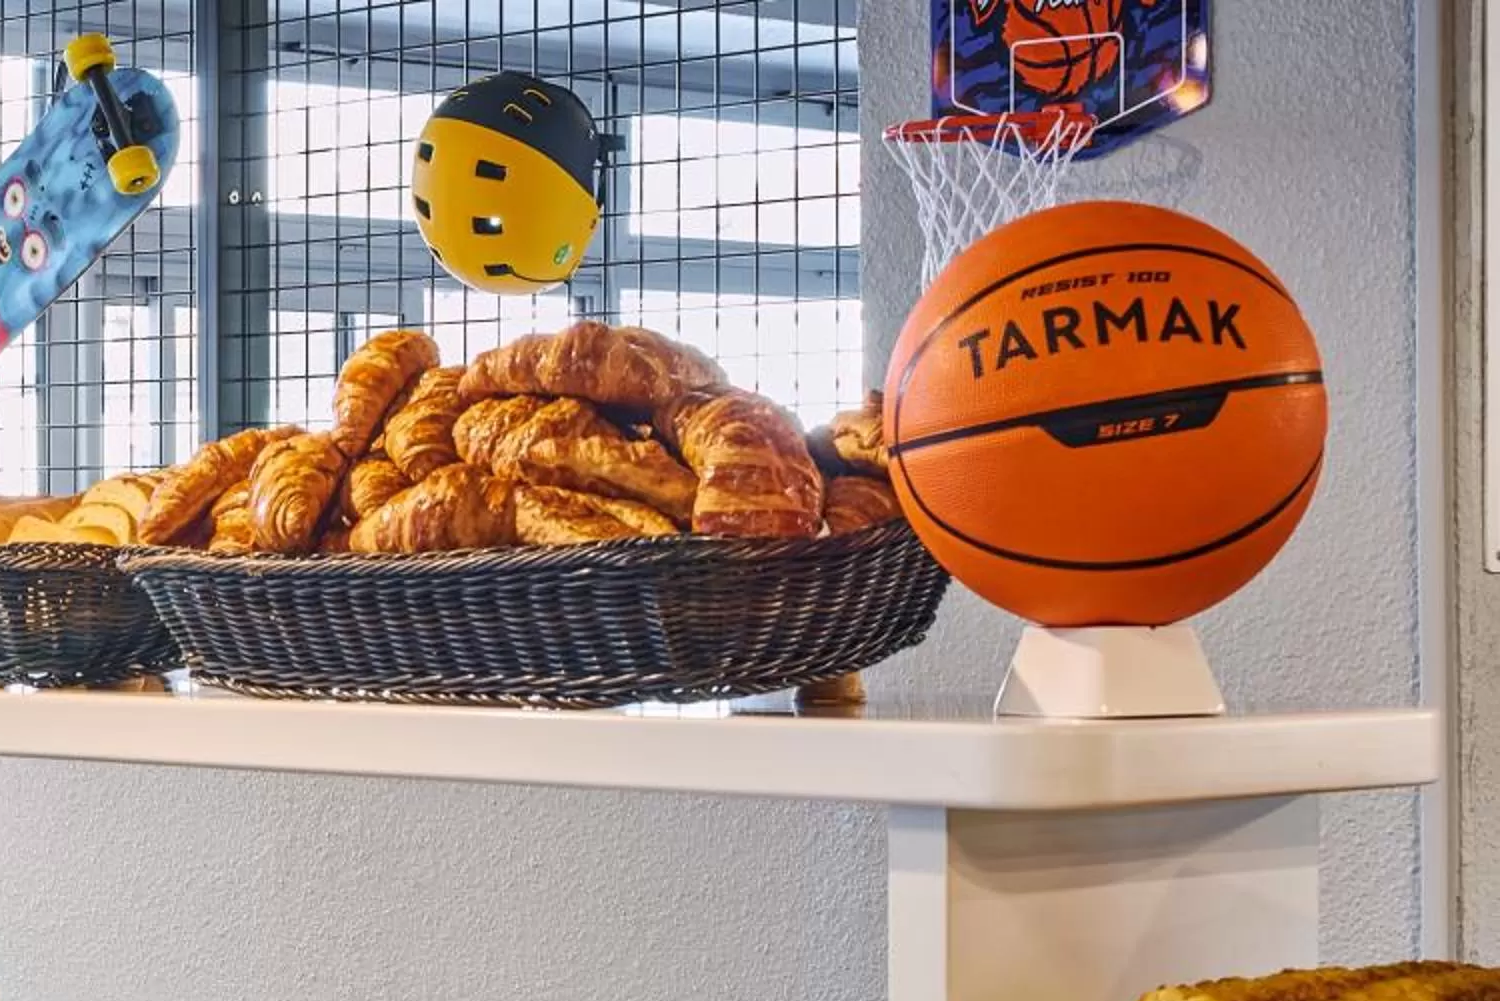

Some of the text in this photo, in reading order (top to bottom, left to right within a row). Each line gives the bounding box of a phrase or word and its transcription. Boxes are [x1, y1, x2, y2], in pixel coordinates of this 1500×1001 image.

[1020, 270, 1172, 301] RESIST 100
[958, 296, 1247, 380] TARMAK
[1096, 413, 1181, 440] SIZE 7
